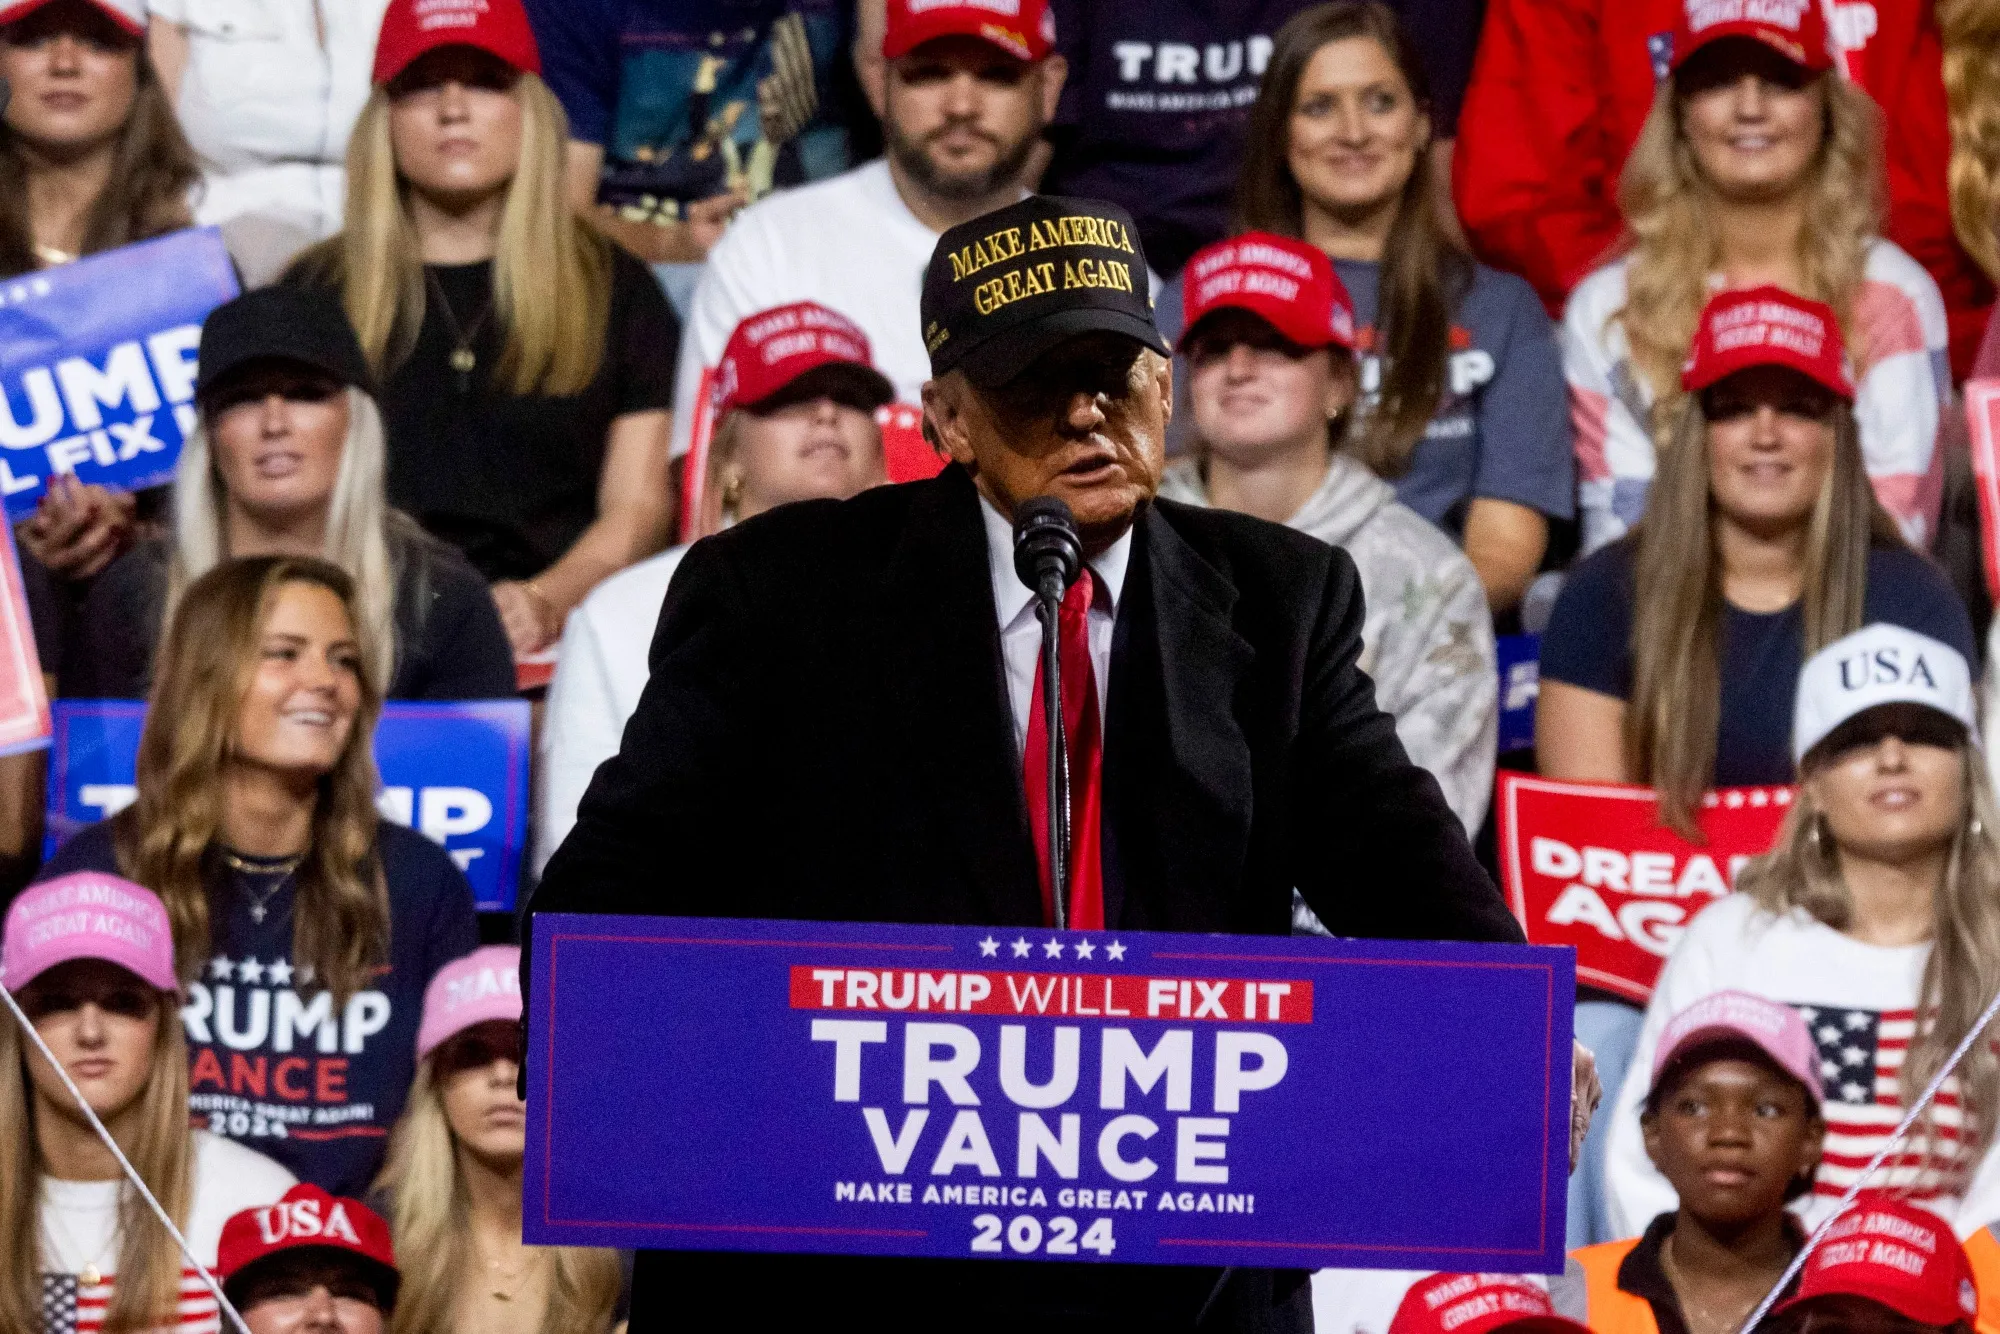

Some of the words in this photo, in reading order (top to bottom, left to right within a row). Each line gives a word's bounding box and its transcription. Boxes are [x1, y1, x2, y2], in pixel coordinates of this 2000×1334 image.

[947, 227, 1025, 282] MAKE
[1029, 216, 1135, 254] AMERICA
[973, 262, 1056, 316] GREAT
[1063, 258, 1133, 293] AGAIN
[46, 412, 167, 475] FIX
[1838, 646, 1938, 691] USA
[180, 980, 392, 1055] RUMP
[813, 970, 991, 1011] TRUMP
[1006, 976, 1131, 1016] WILL
[1147, 980, 1229, 1019] FIX
[1244, 983, 1292, 1021] IT
[190, 1048, 350, 1102] ANCE
[811, 1019, 1290, 1113] TRUMP
[188, 1093, 251, 1113] MERICA
[210, 1112, 289, 1139] 2024
[862, 1108, 1231, 1184] VANCE
[255, 1199, 361, 1245] USA
[835, 1182, 912, 1203] MAKE
[922, 1184, 1049, 1208] AMERICA
[1058, 1189, 1148, 1211] GREAT
[1157, 1192, 1256, 1214] AGAIN!
[970, 1213, 1117, 1256] 2024
